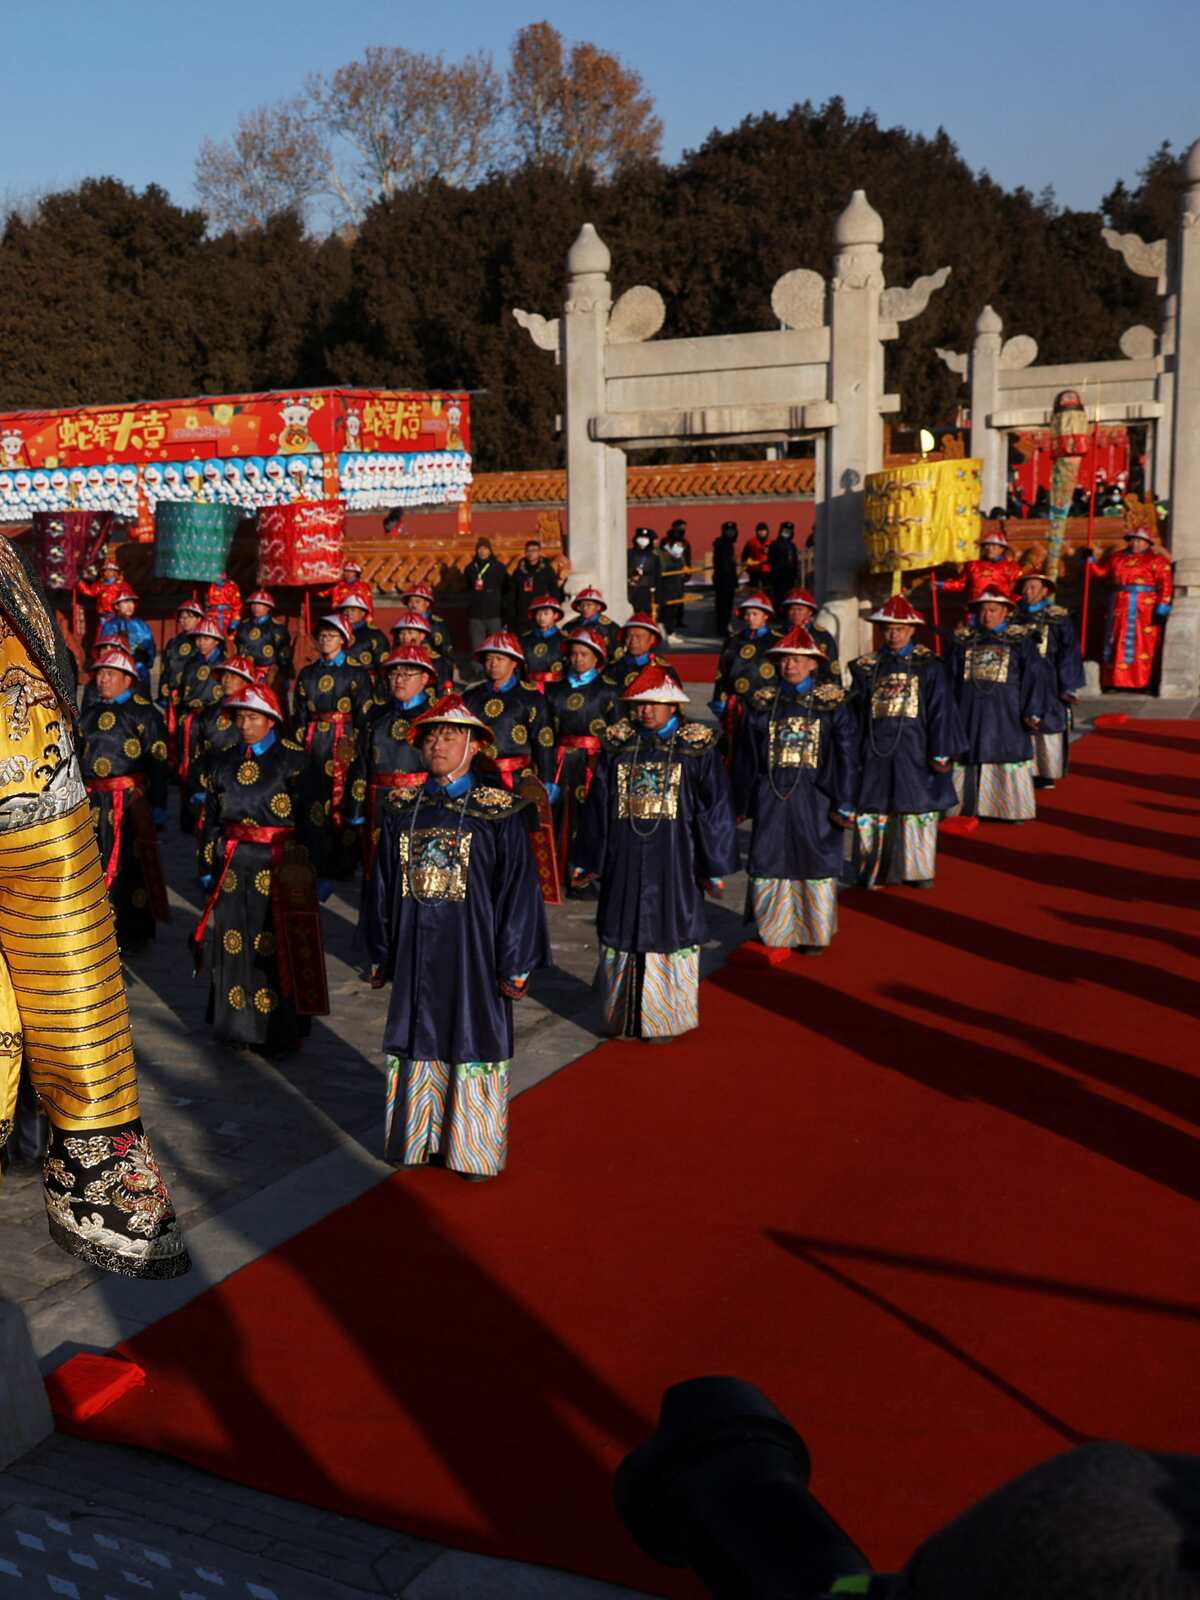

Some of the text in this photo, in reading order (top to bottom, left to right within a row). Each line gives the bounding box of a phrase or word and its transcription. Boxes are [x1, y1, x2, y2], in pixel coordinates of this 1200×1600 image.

[58, 410, 170, 451] 蛇年大吉
[362, 399, 421, 441] 蛇年大吉
